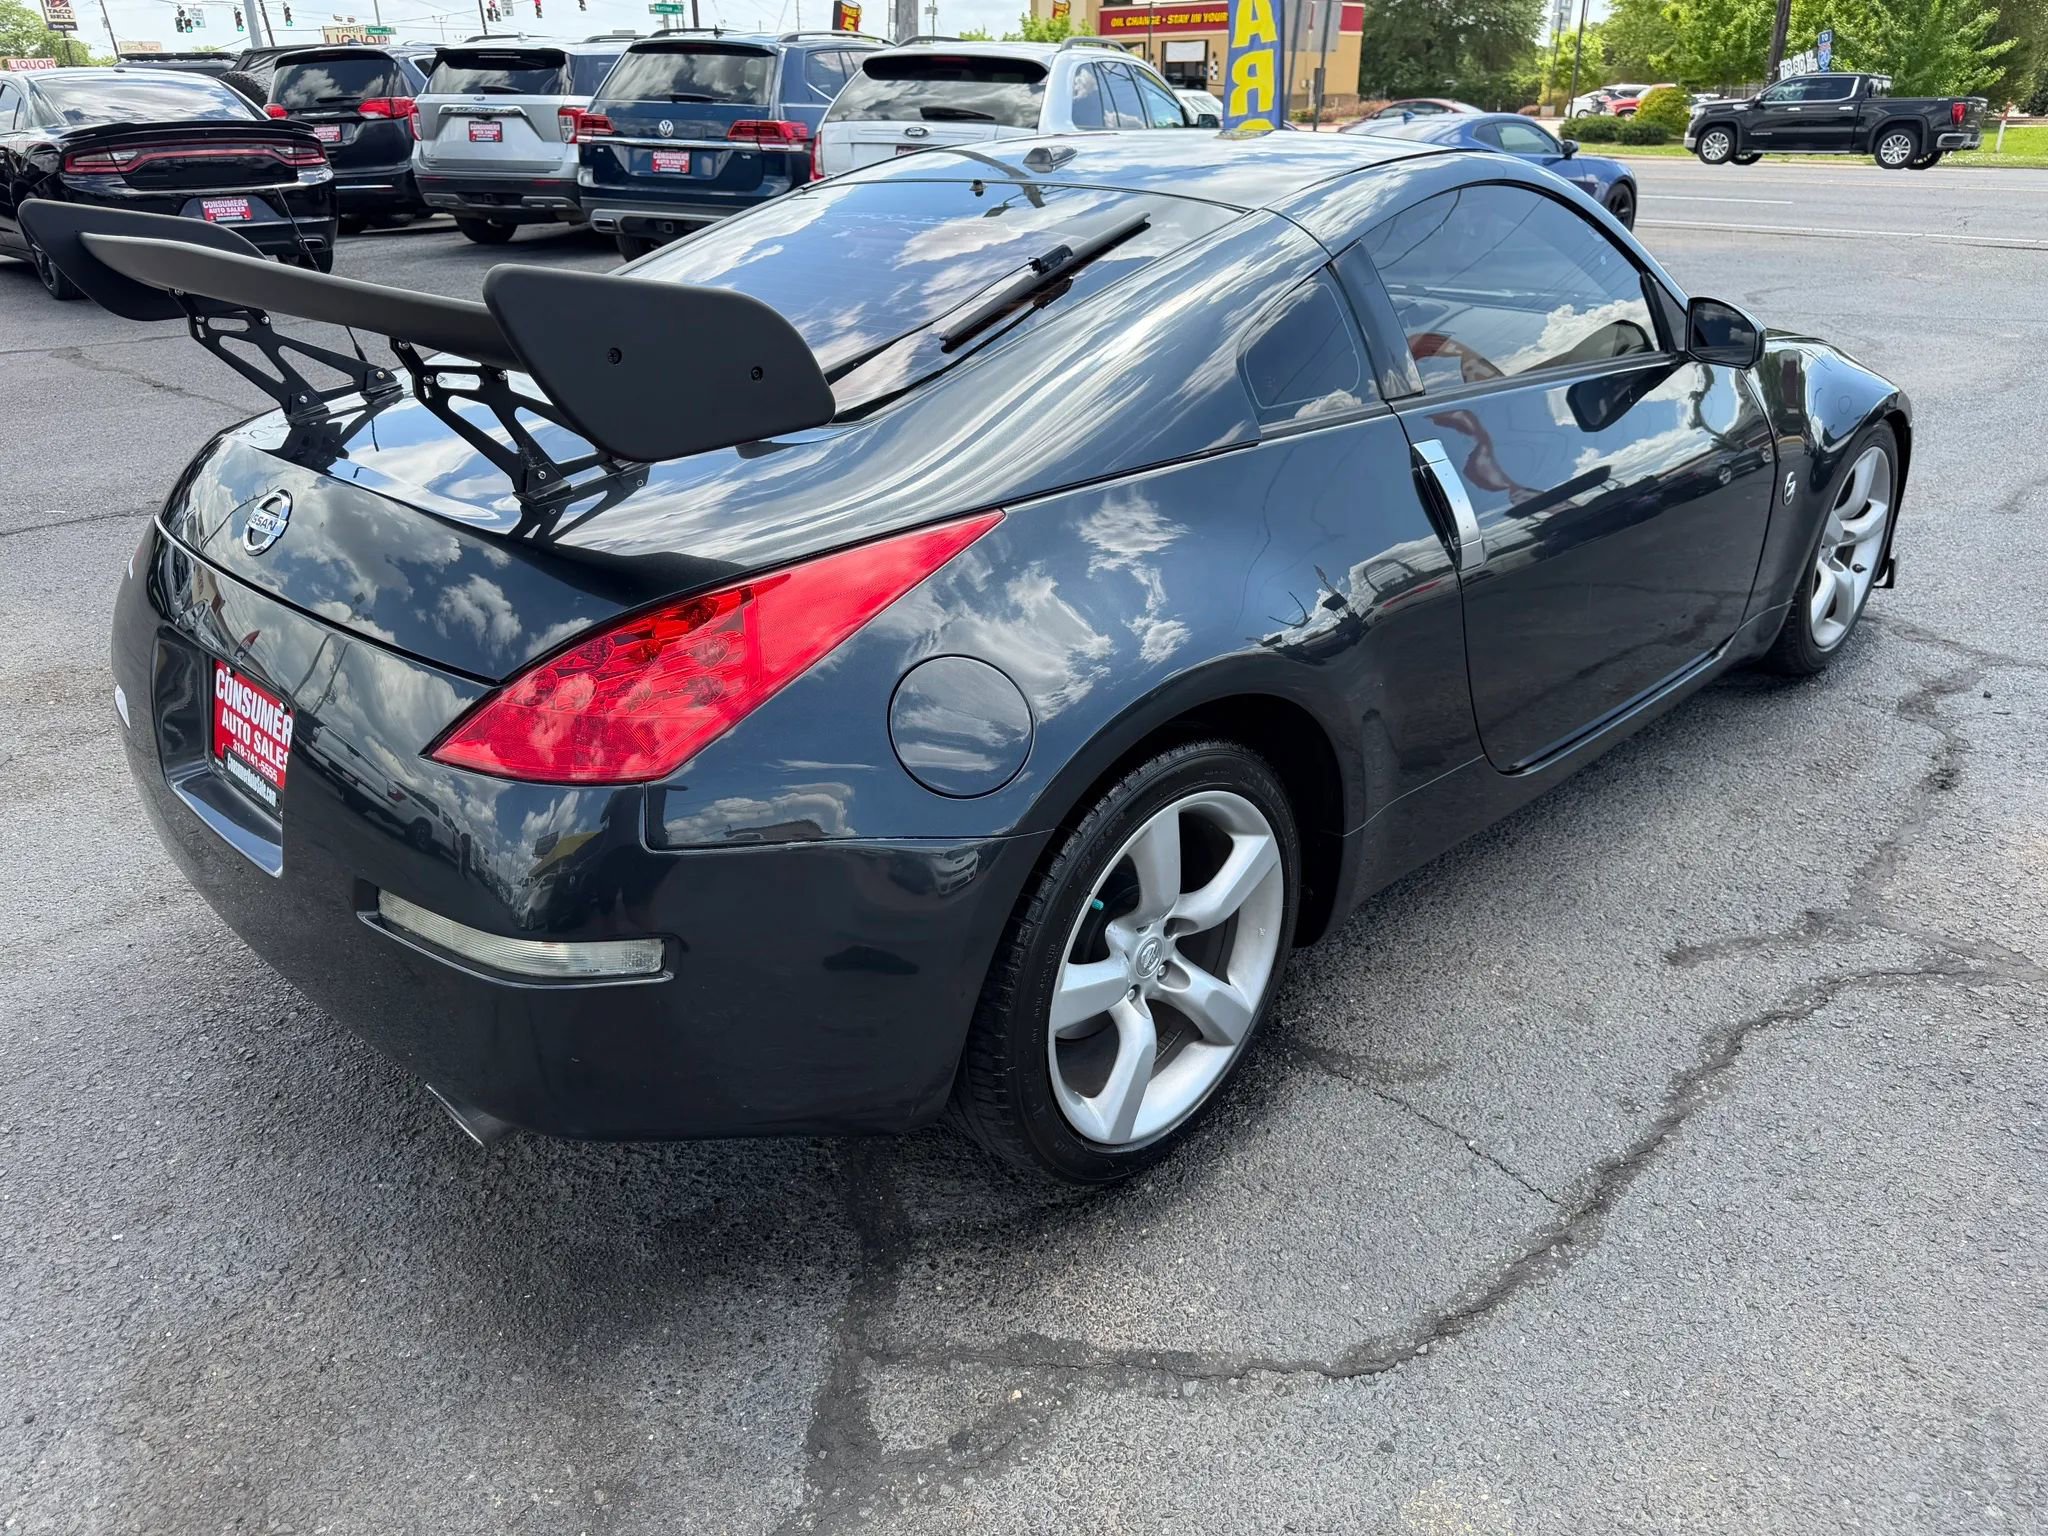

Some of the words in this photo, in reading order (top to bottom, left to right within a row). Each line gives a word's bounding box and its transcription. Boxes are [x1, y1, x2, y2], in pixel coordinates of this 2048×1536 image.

[1111, 17, 1124, 27] OIL
[1126, 15, 1161, 26] CHANGE
[1167, 14, 1190, 24] STAY
[1203, 12, 1229, 22] YOUR
[9, 60, 55, 70] LIQUOR
[203, 199, 248, 208] CONSUMERS
[250, 512, 278, 531] SSAN
[222, 707, 251, 746] AUTO
[233, 739, 278, 783] 318-741-5555
